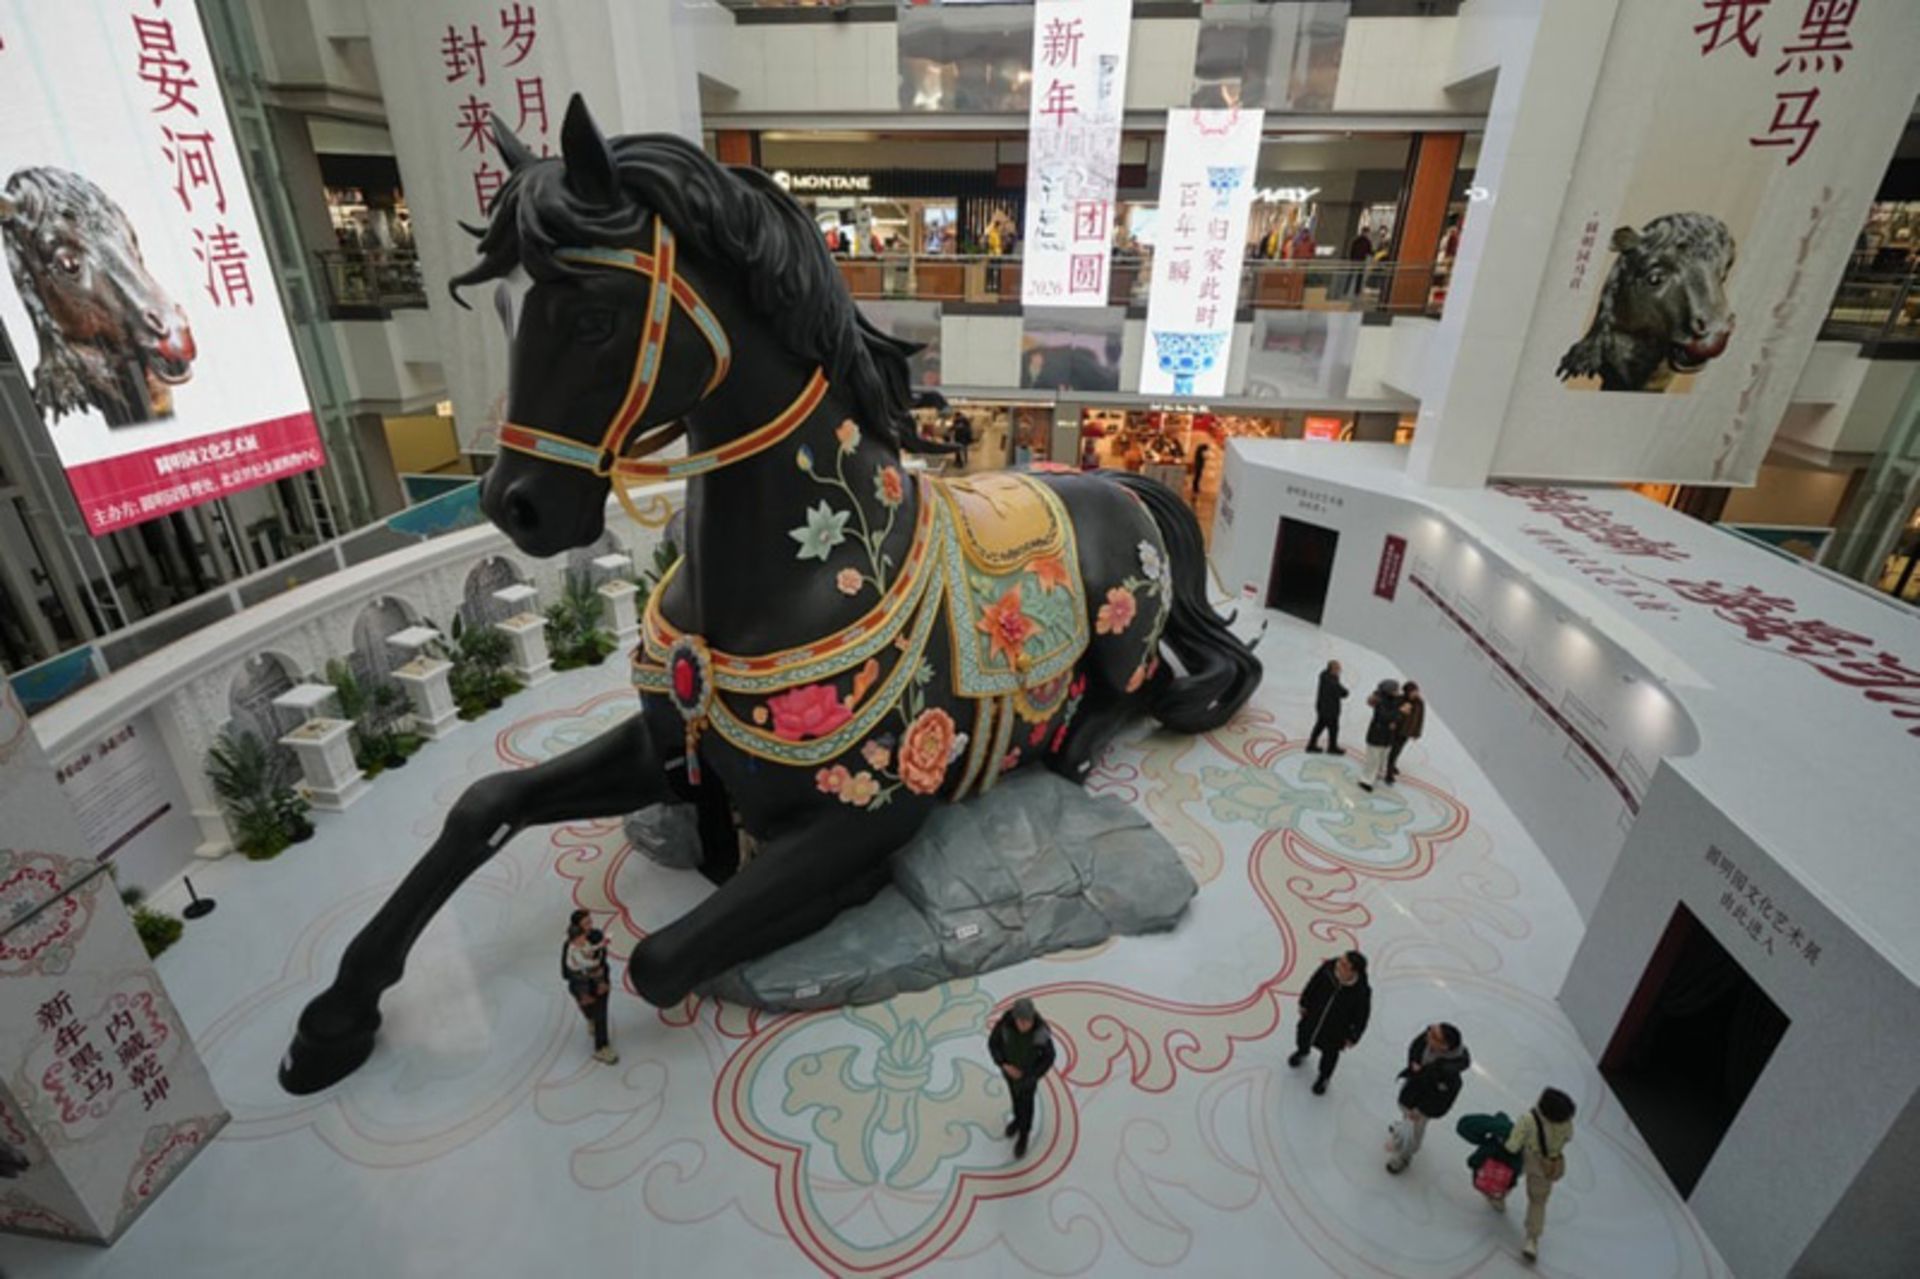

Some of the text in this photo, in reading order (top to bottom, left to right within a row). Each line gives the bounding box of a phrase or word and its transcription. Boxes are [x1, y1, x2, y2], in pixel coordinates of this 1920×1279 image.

[500, 3, 549, 160] 岁月
[1039, 18, 1084, 128] 新年
[1693, 0, 1770, 58] 我
[1749, 0, 1860, 166] 黑马
[132, 0, 254, 308] 晏河清
[440, 24, 504, 217] 封来自
[792, 175, 870, 190] MONTANE
[1195, 217, 1230, 329] 归家此时
[35, 989, 114, 1102] 新年黑马
